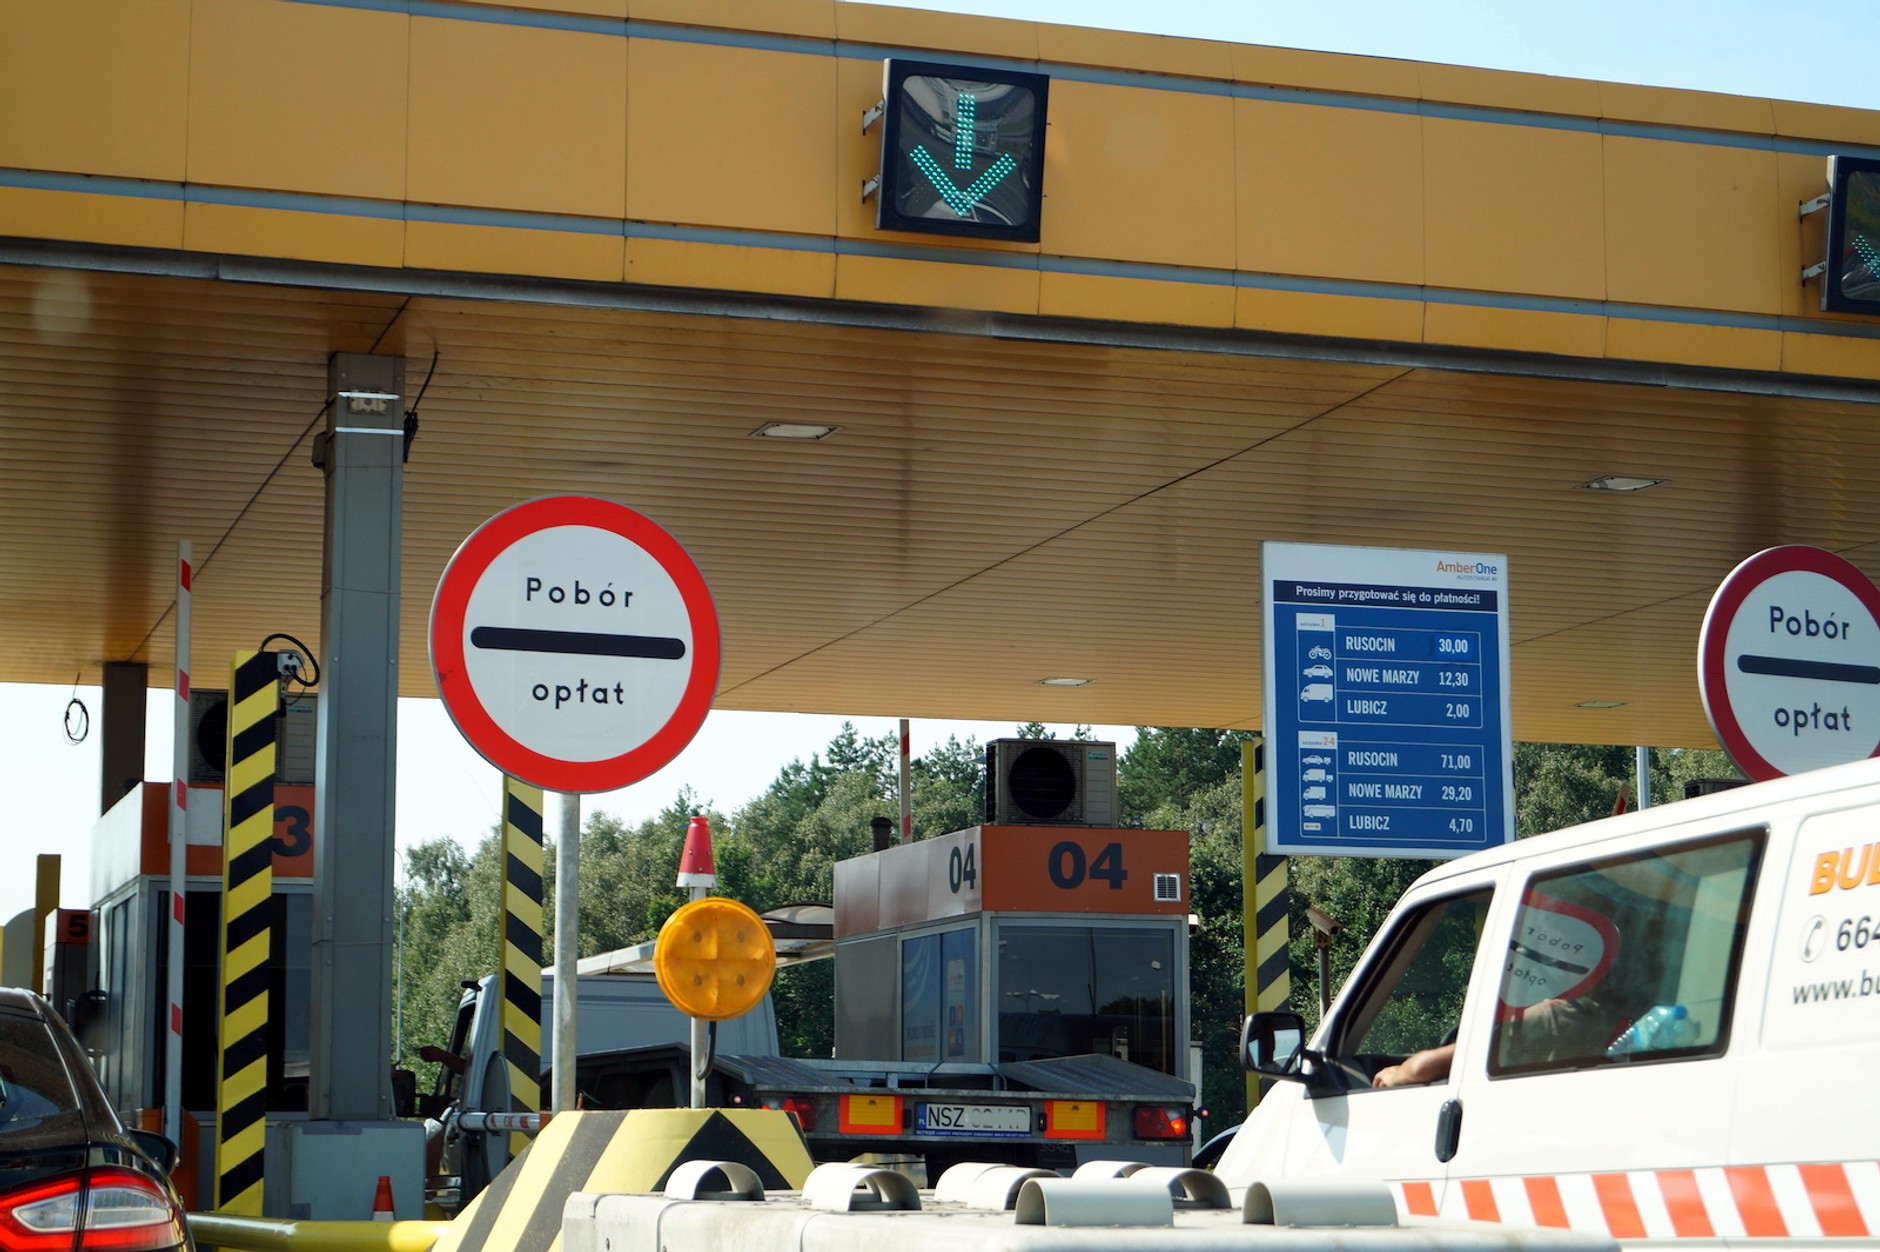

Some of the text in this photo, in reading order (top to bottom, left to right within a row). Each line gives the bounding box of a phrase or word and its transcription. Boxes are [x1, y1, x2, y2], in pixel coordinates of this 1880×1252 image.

[1436, 560, 1497, 575] AmberOne
[526, 577, 633, 608] Pobór
[1296, 585, 1480, 605] Prosimy przygotować się do płatności!
[1770, 605, 1850, 640] Pobór
[1346, 636, 1468, 654] RUSOCIN 30,00
[1346, 669, 1468, 687] NOWE MARZY 12,30
[532, 679, 624, 709] opłat
[1347, 701, 1469, 719] LUBICZ 2,00
[1774, 702, 1851, 736] opłat
[1348, 752, 1470, 770] RUSOCIN 71,00
[1349, 783, 1472, 801] NOWE MARZY 29,20
[1350, 815, 1473, 833] LUBICZ 4,70
[949, 842, 976, 894] 04
[1048, 840, 1128, 890] 04
[68, 915, 88, 937] 5
[928, 1106, 965, 1128] NSZ
